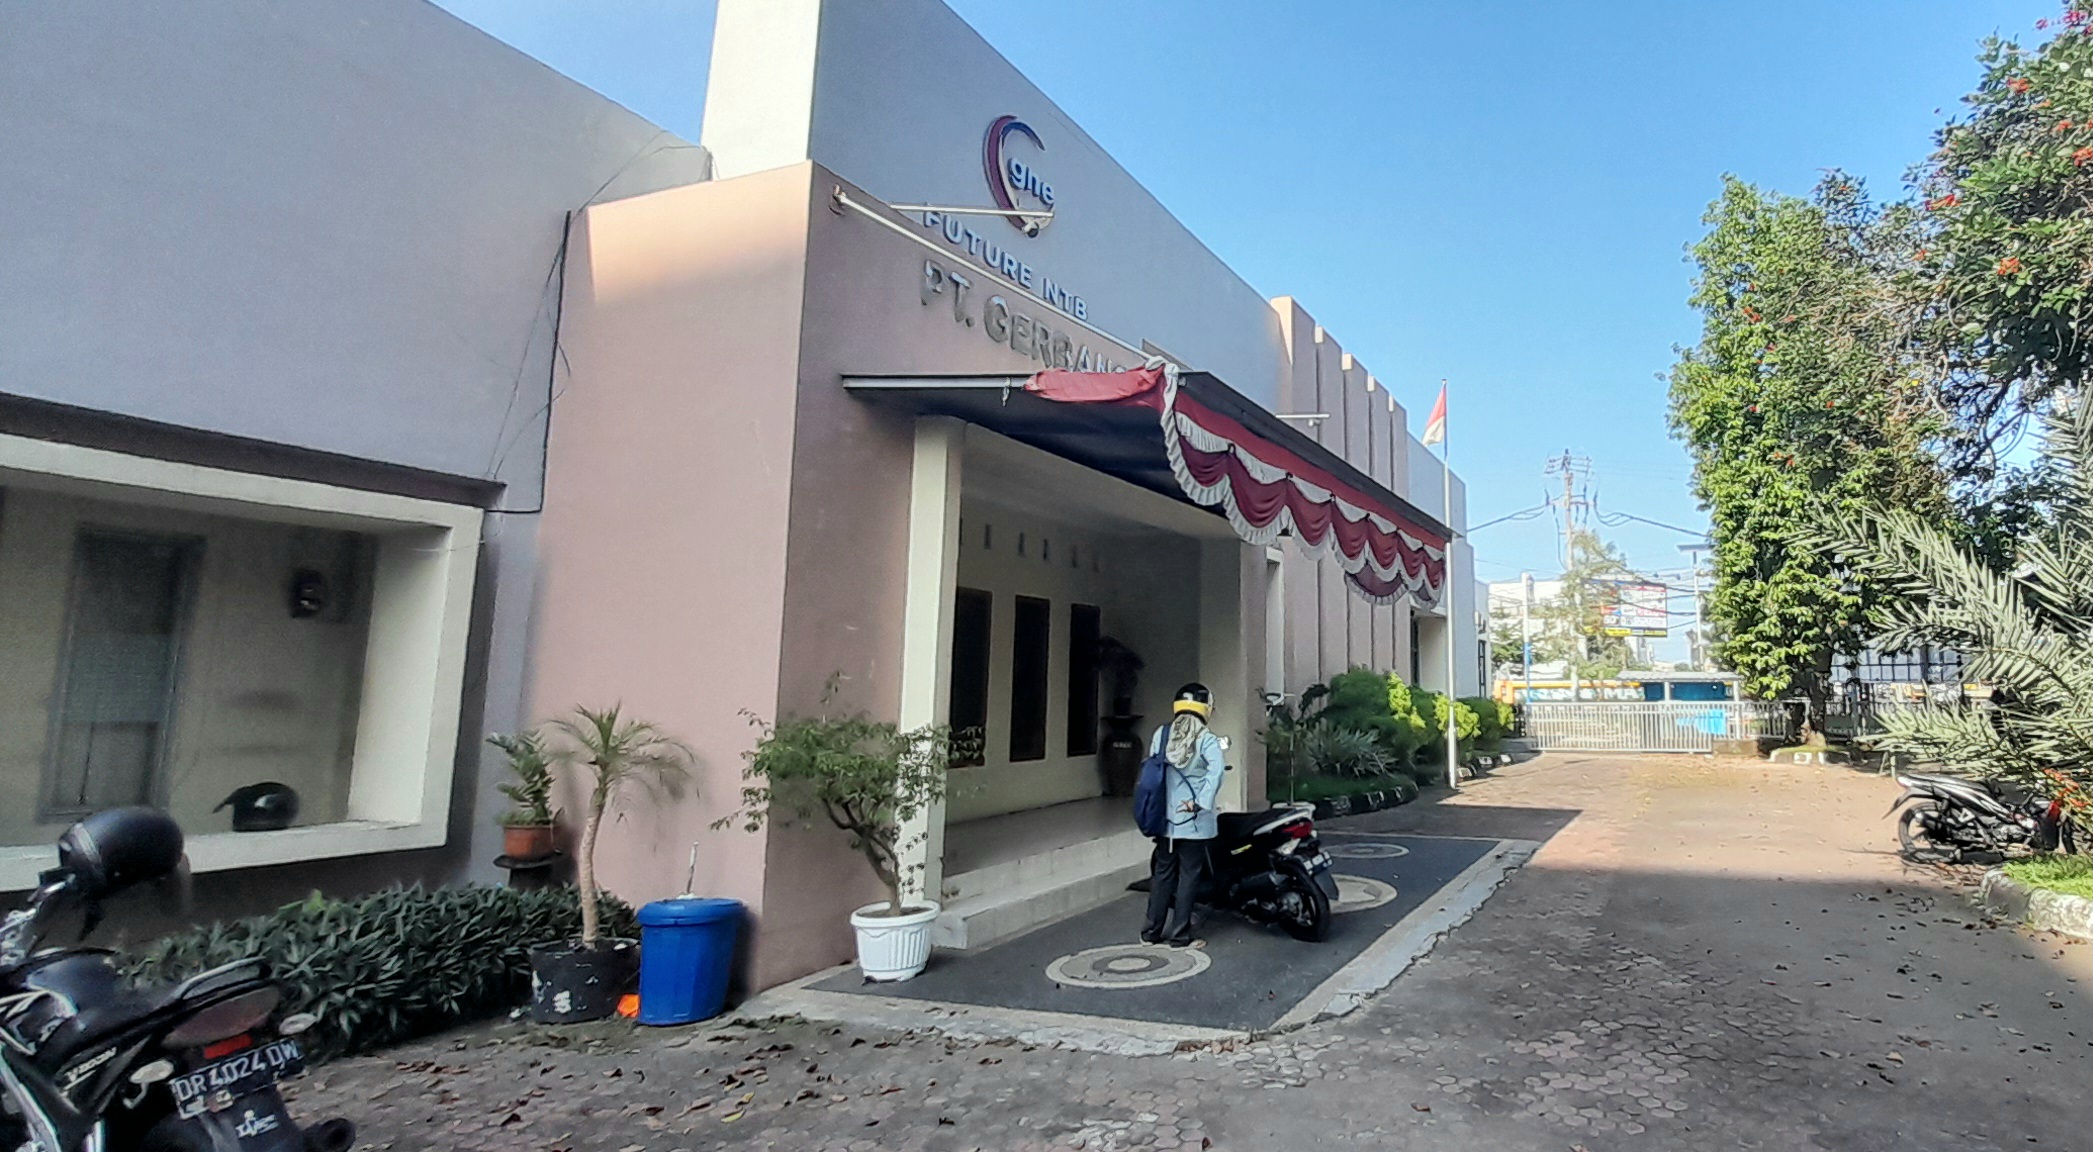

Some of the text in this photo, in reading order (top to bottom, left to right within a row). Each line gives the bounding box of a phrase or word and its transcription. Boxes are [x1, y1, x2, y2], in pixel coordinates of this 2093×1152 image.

[1008, 157, 1054, 205] gne
[923, 203, 1088, 320] FUTURE NTB
[921, 260, 1127, 373] PT. GERBAN
[176, 1075, 207, 1102] DR
[209, 1052, 267, 1086] 4024
